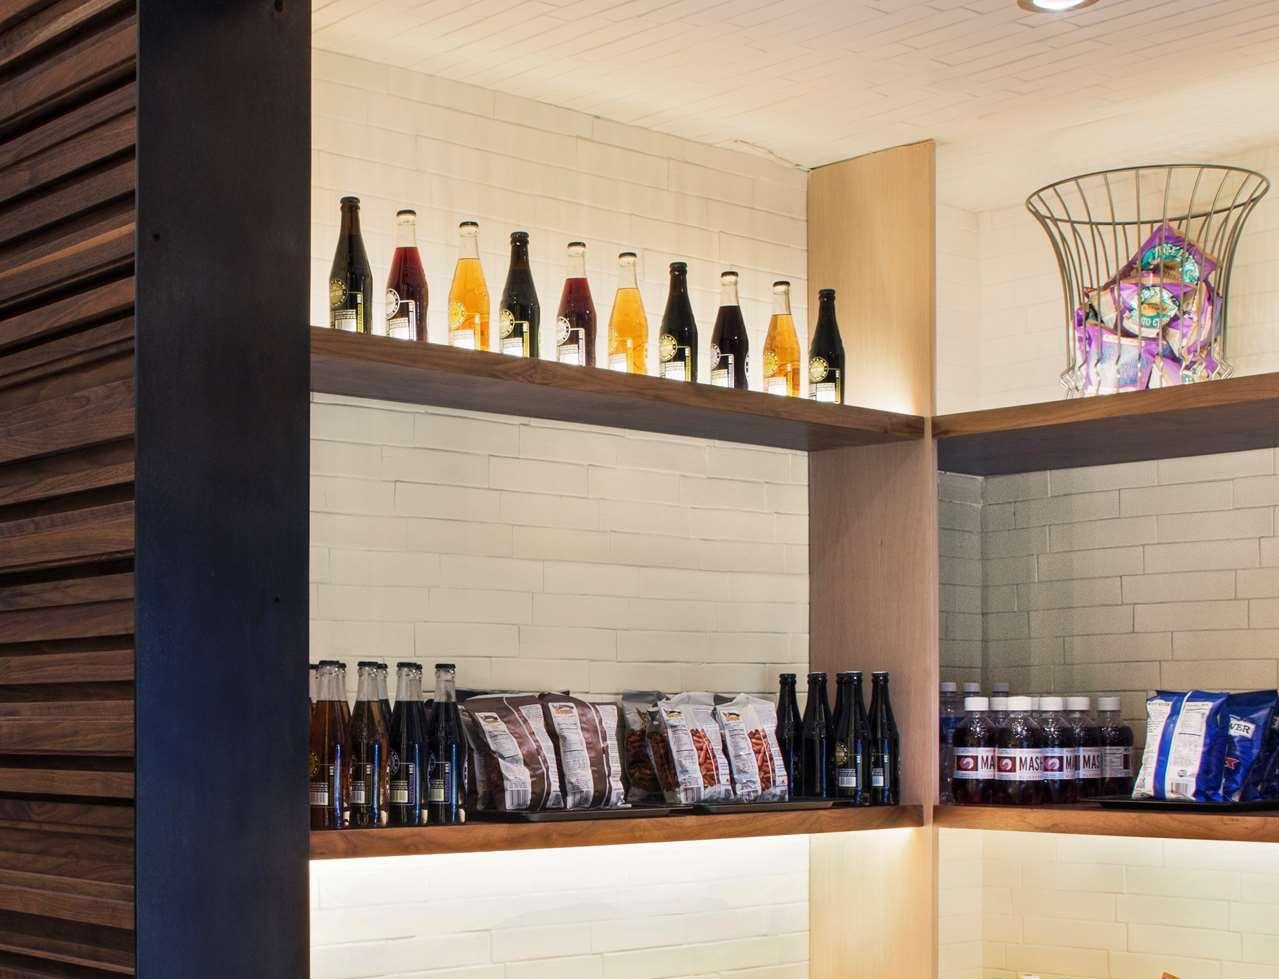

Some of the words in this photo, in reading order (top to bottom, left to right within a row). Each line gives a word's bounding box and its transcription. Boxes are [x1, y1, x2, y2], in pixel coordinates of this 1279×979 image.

[1230, 722, 1251, 734] VER
[980, 754, 994, 769] MA
[1082, 754, 1100, 769] MAS
